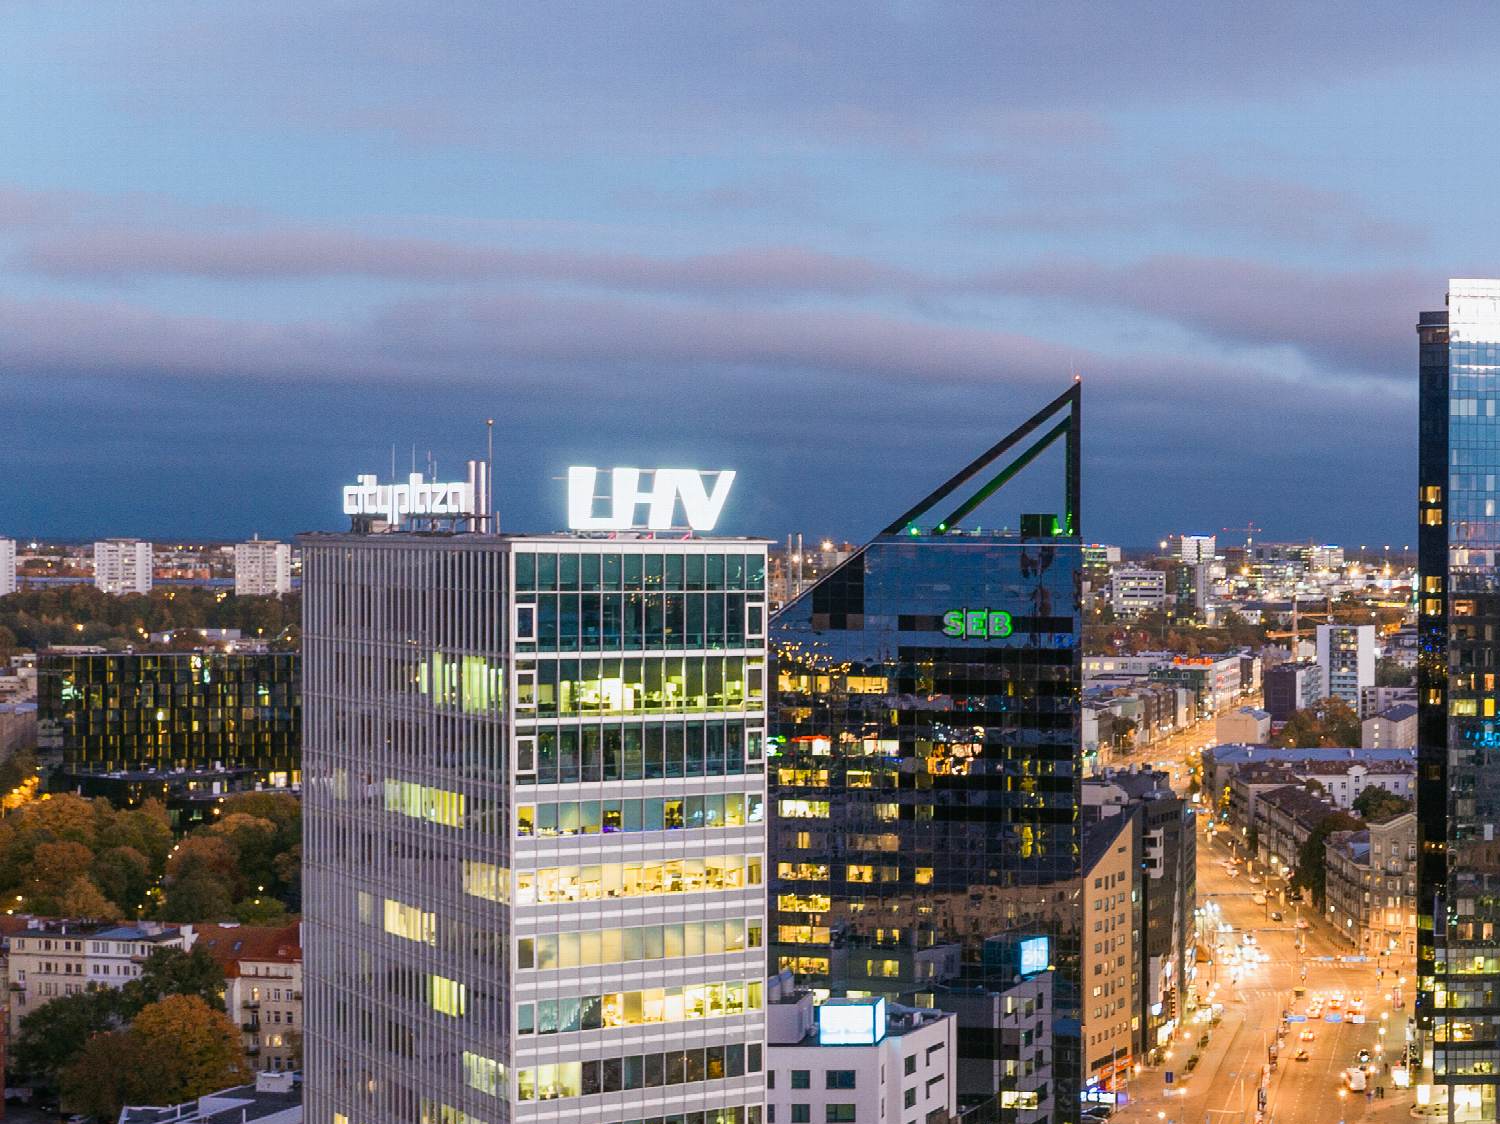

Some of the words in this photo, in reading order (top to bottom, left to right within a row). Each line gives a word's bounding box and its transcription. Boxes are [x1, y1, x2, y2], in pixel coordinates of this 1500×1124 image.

[343, 473, 467, 525] cityplaza
[567, 466, 737, 531] LHV
[943, 609, 1013, 638] SEB
